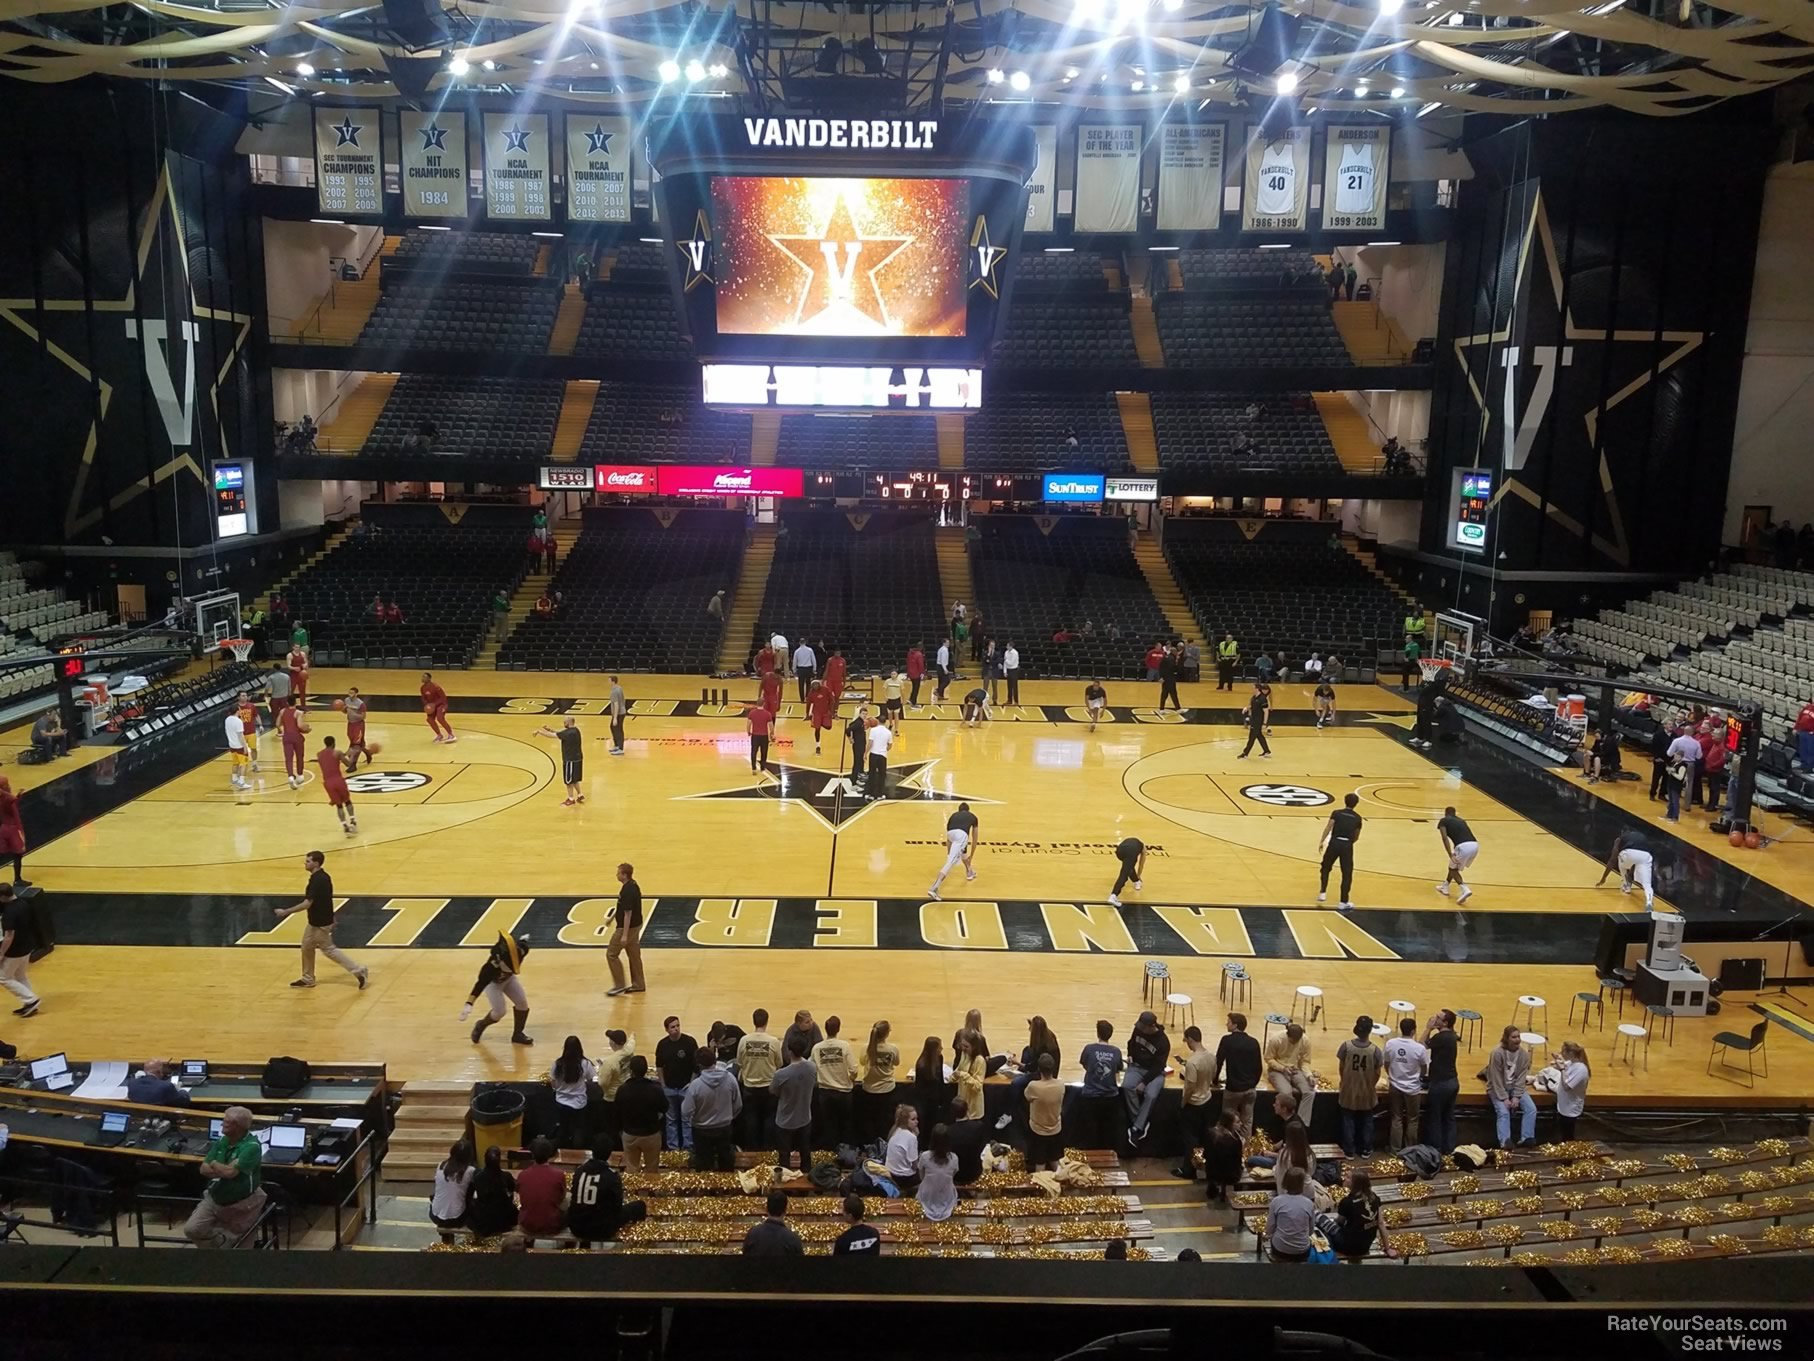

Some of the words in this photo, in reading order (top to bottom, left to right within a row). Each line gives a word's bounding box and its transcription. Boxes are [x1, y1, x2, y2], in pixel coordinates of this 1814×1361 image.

[744, 118, 938, 149] VANDERBILT
[1087, 130, 1103, 140] SEC
[1105, 129, 1134, 140] PLAYER
[1338, 129, 1380, 140] ANDERSON
[1086, 140, 1097, 150] OF
[1099, 140, 1112, 151] THE
[1115, 140, 1134, 151] YEAR
[323, 154, 335, 162] SEC
[336, 155, 374, 163] TOURNAMENT
[426, 155, 442, 167] NIT
[507, 159, 528, 169] NCAA
[323, 162, 376, 175] CHAMPIONS
[589, 161, 610, 171] NCAA
[1260, 165, 1294, 177] VANDERBILT
[1339, 165, 1373, 176] VANDERBILT
[408, 167, 460, 179] CHAMPIONS
[493, 169, 543, 180] TOURNAMENT
[574, 170, 624, 182] TOURNAMENT
[325, 175, 346, 185] 1993
[354, 176, 375, 186] 1995
[494, 180, 515, 190] 1986
[523, 181, 543, 191] 1987
[1268, 175, 1286, 191] 40
[1347, 175, 1363, 190] 21
[325, 187, 346, 198] 2002
[354, 188, 375, 198] 2004
[604, 183, 625, 193] 2007
[420, 191, 449, 205] 1984
[575, 195, 596, 205] 2010
[604, 196, 624, 206] 2011
[326, 199, 347, 209] 2007
[355, 200, 376, 210] 2009
[495, 204, 516, 214] 2000
[524, 205, 545, 215] 2003
[576, 208, 597, 218] 2012
[604, 209, 625, 219] 2013
[688, 241, 705, 271] V
[978, 247, 994, 277] V
[124, 318, 200, 446] V
[1501, 346, 1574, 470] V
[876, 475, 883, 485] 4
[909, 472, 937, 483] 49:11
[963, 476, 970, 486] 4
[882, 487, 889, 497] 0
[904, 488, 911, 498] 0
[1119, 483, 1155, 492] LOTTERY
[942, 488, 949, 499] 0
[962, 488, 970, 499] 0
[1021, 847, 1080, 856] Court
[235, 897, 1403, 960] VANDERBILT
[1352, 1054, 1367, 1071] 24
[576, 1171, 601, 1205] 16
